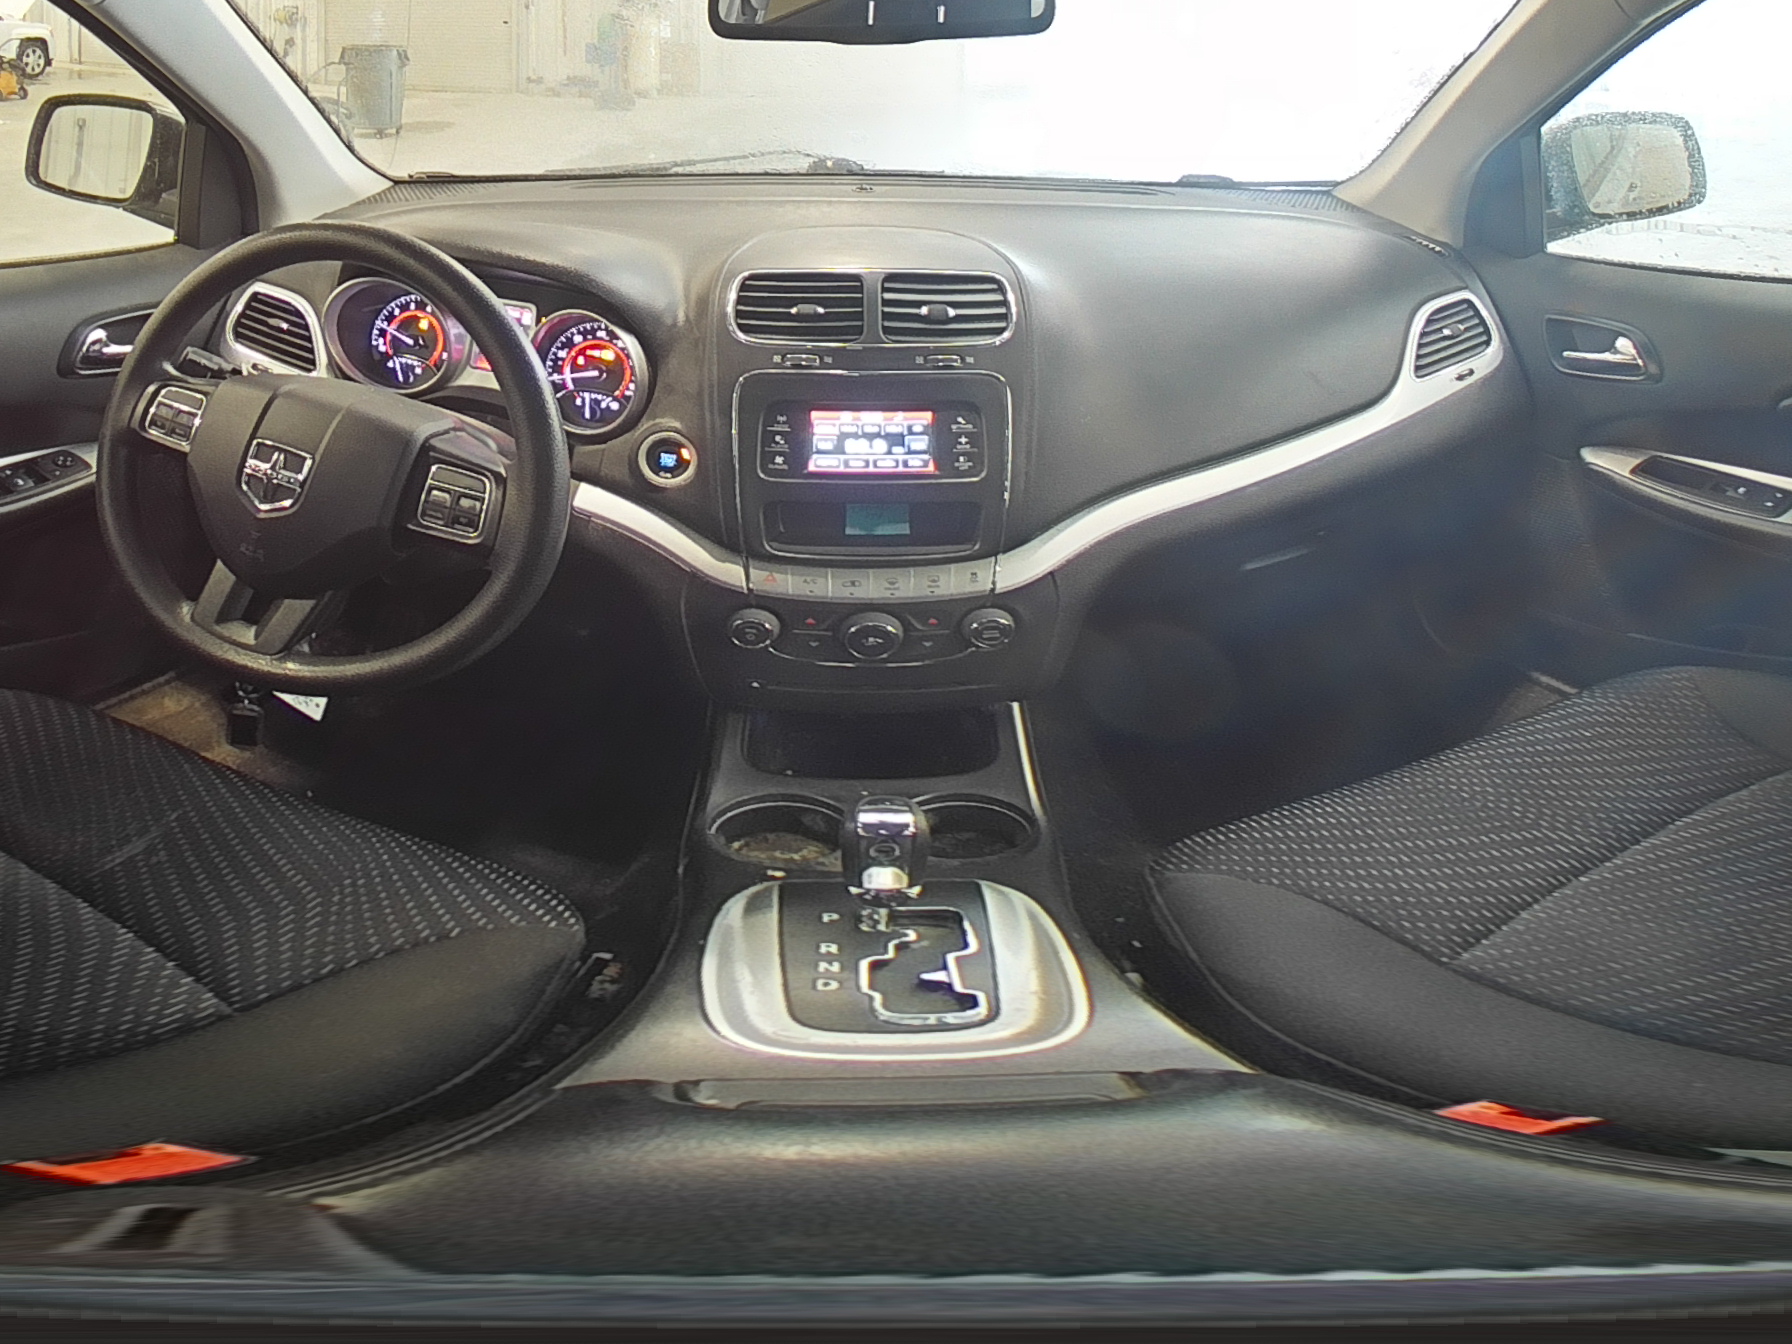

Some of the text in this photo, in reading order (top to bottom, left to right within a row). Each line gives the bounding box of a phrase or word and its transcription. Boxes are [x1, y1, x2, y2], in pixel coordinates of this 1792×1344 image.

[821, 912, 841, 923] P
[818, 942, 840, 955] R
[817, 961, 841, 973] N
[815, 978, 841, 991] D
